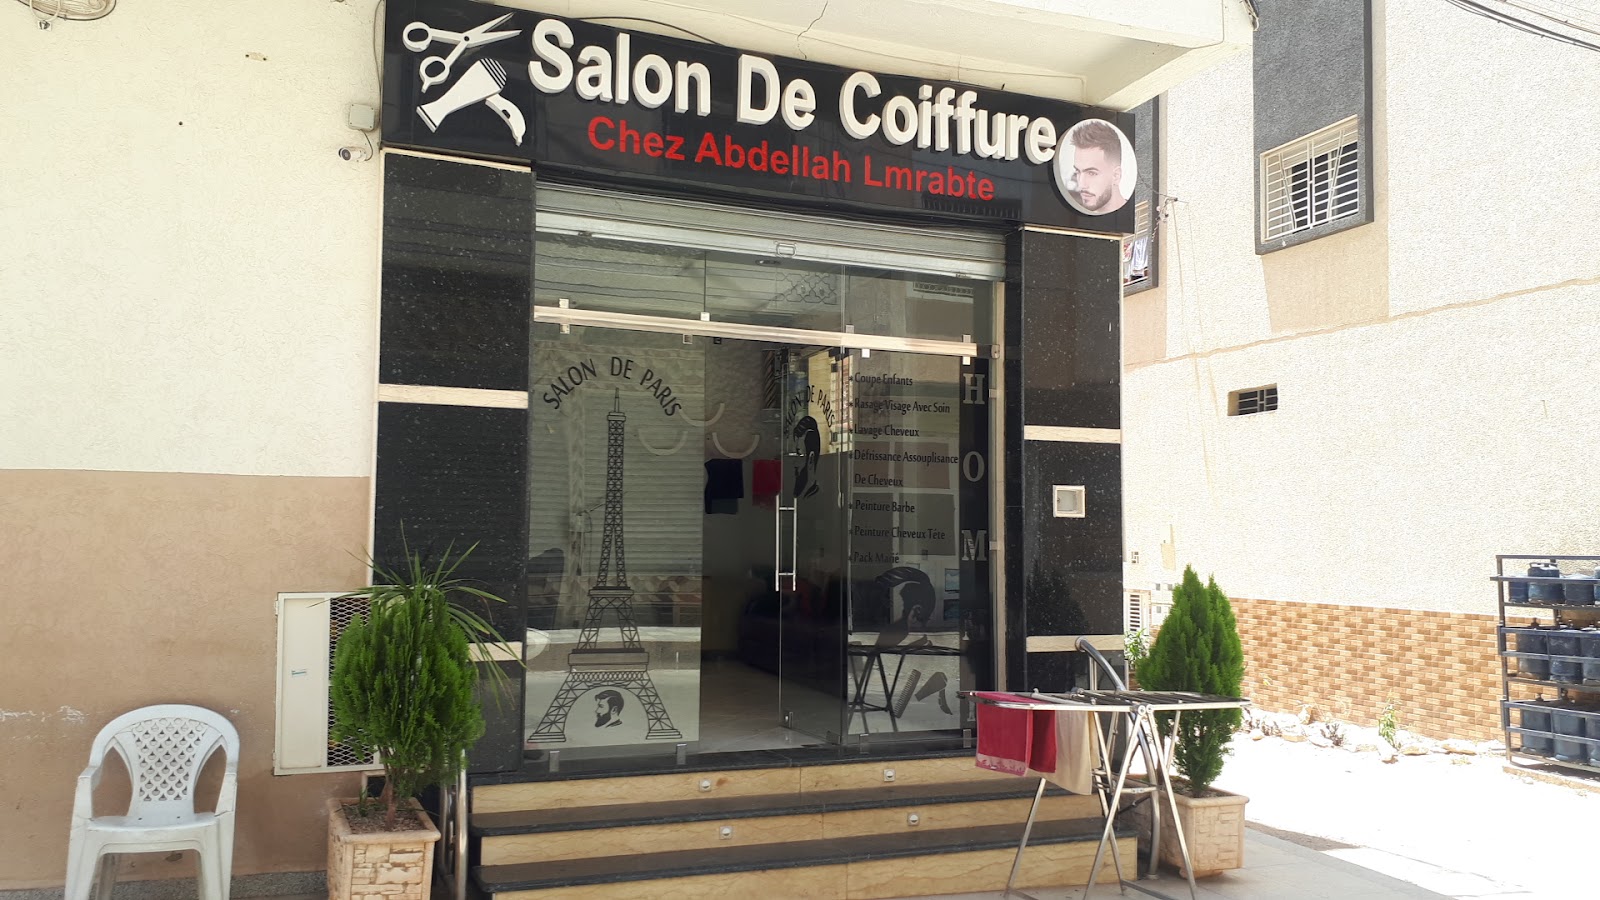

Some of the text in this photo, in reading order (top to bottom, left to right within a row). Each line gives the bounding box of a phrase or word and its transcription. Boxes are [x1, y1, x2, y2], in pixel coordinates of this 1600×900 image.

[528, 18, 1057, 165] Salon De Coiffure
[587, 116, 995, 201] Chez Abdellah Lmrabte
[543, 356, 682, 416] SALON DE PARIS
[854, 372, 913, 387] Coupe Enfants
[816, 389, 836, 428] PARIS
[854, 398, 951, 415] Rasage Visage Avec Soin
[854, 424, 920, 439] Lavage Cheveux
[854, 449, 959, 466] Défrissance Assouplisance
[854, 473, 904, 487] De Cheveux
[855, 500, 916, 513] Peinture Barbe
[854, 525, 890, 537] Peinture
[891, 527, 927, 539] Cheveux
[853, 551, 873, 563] Pack
